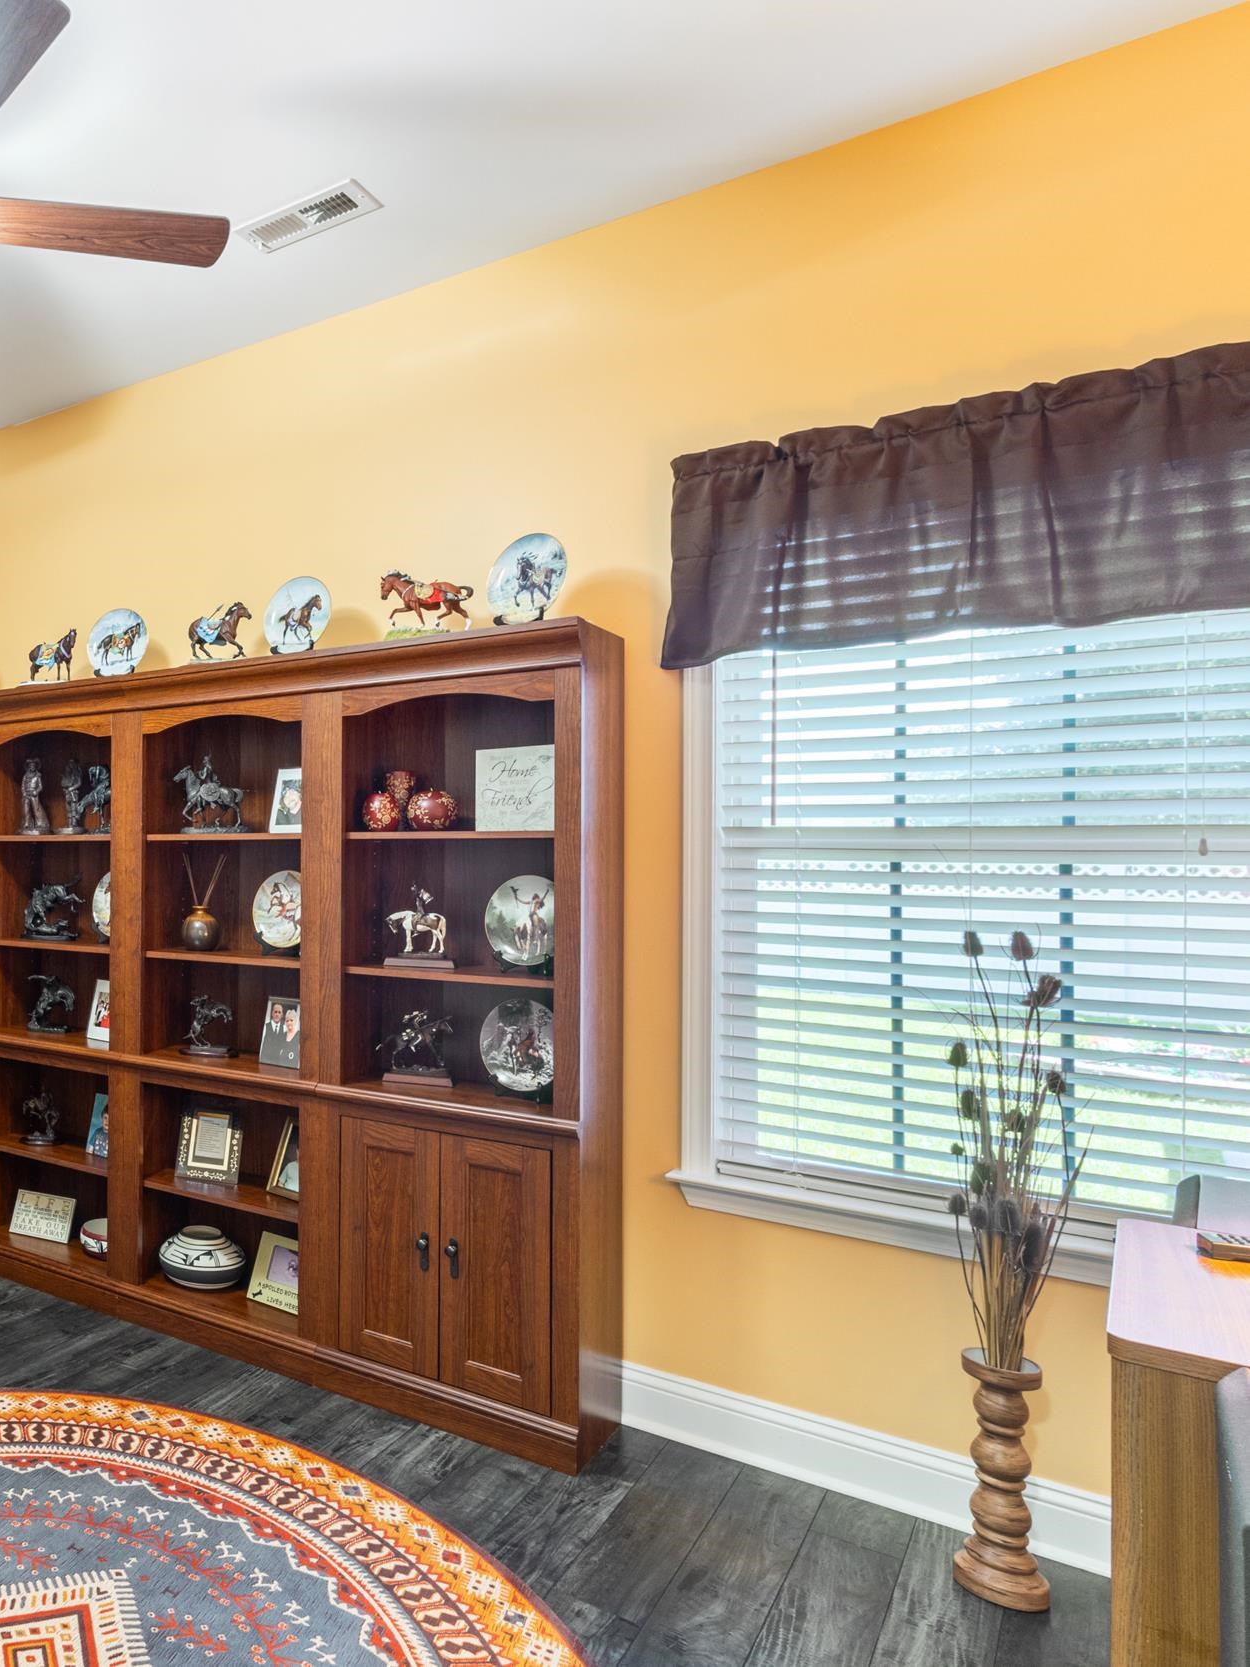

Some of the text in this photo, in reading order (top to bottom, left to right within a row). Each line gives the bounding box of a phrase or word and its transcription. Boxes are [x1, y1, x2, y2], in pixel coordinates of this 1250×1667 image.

[488, 759, 538, 783] Home
[20, 1194, 70, 1211] LIFE
[14, 1223, 64, 1238] BREATH AWAY
[15, 1216, 65, 1231] TAKE OUR
[262, 1284, 283, 1294] SPOILED
[267, 1297, 282, 1306] LIVES
